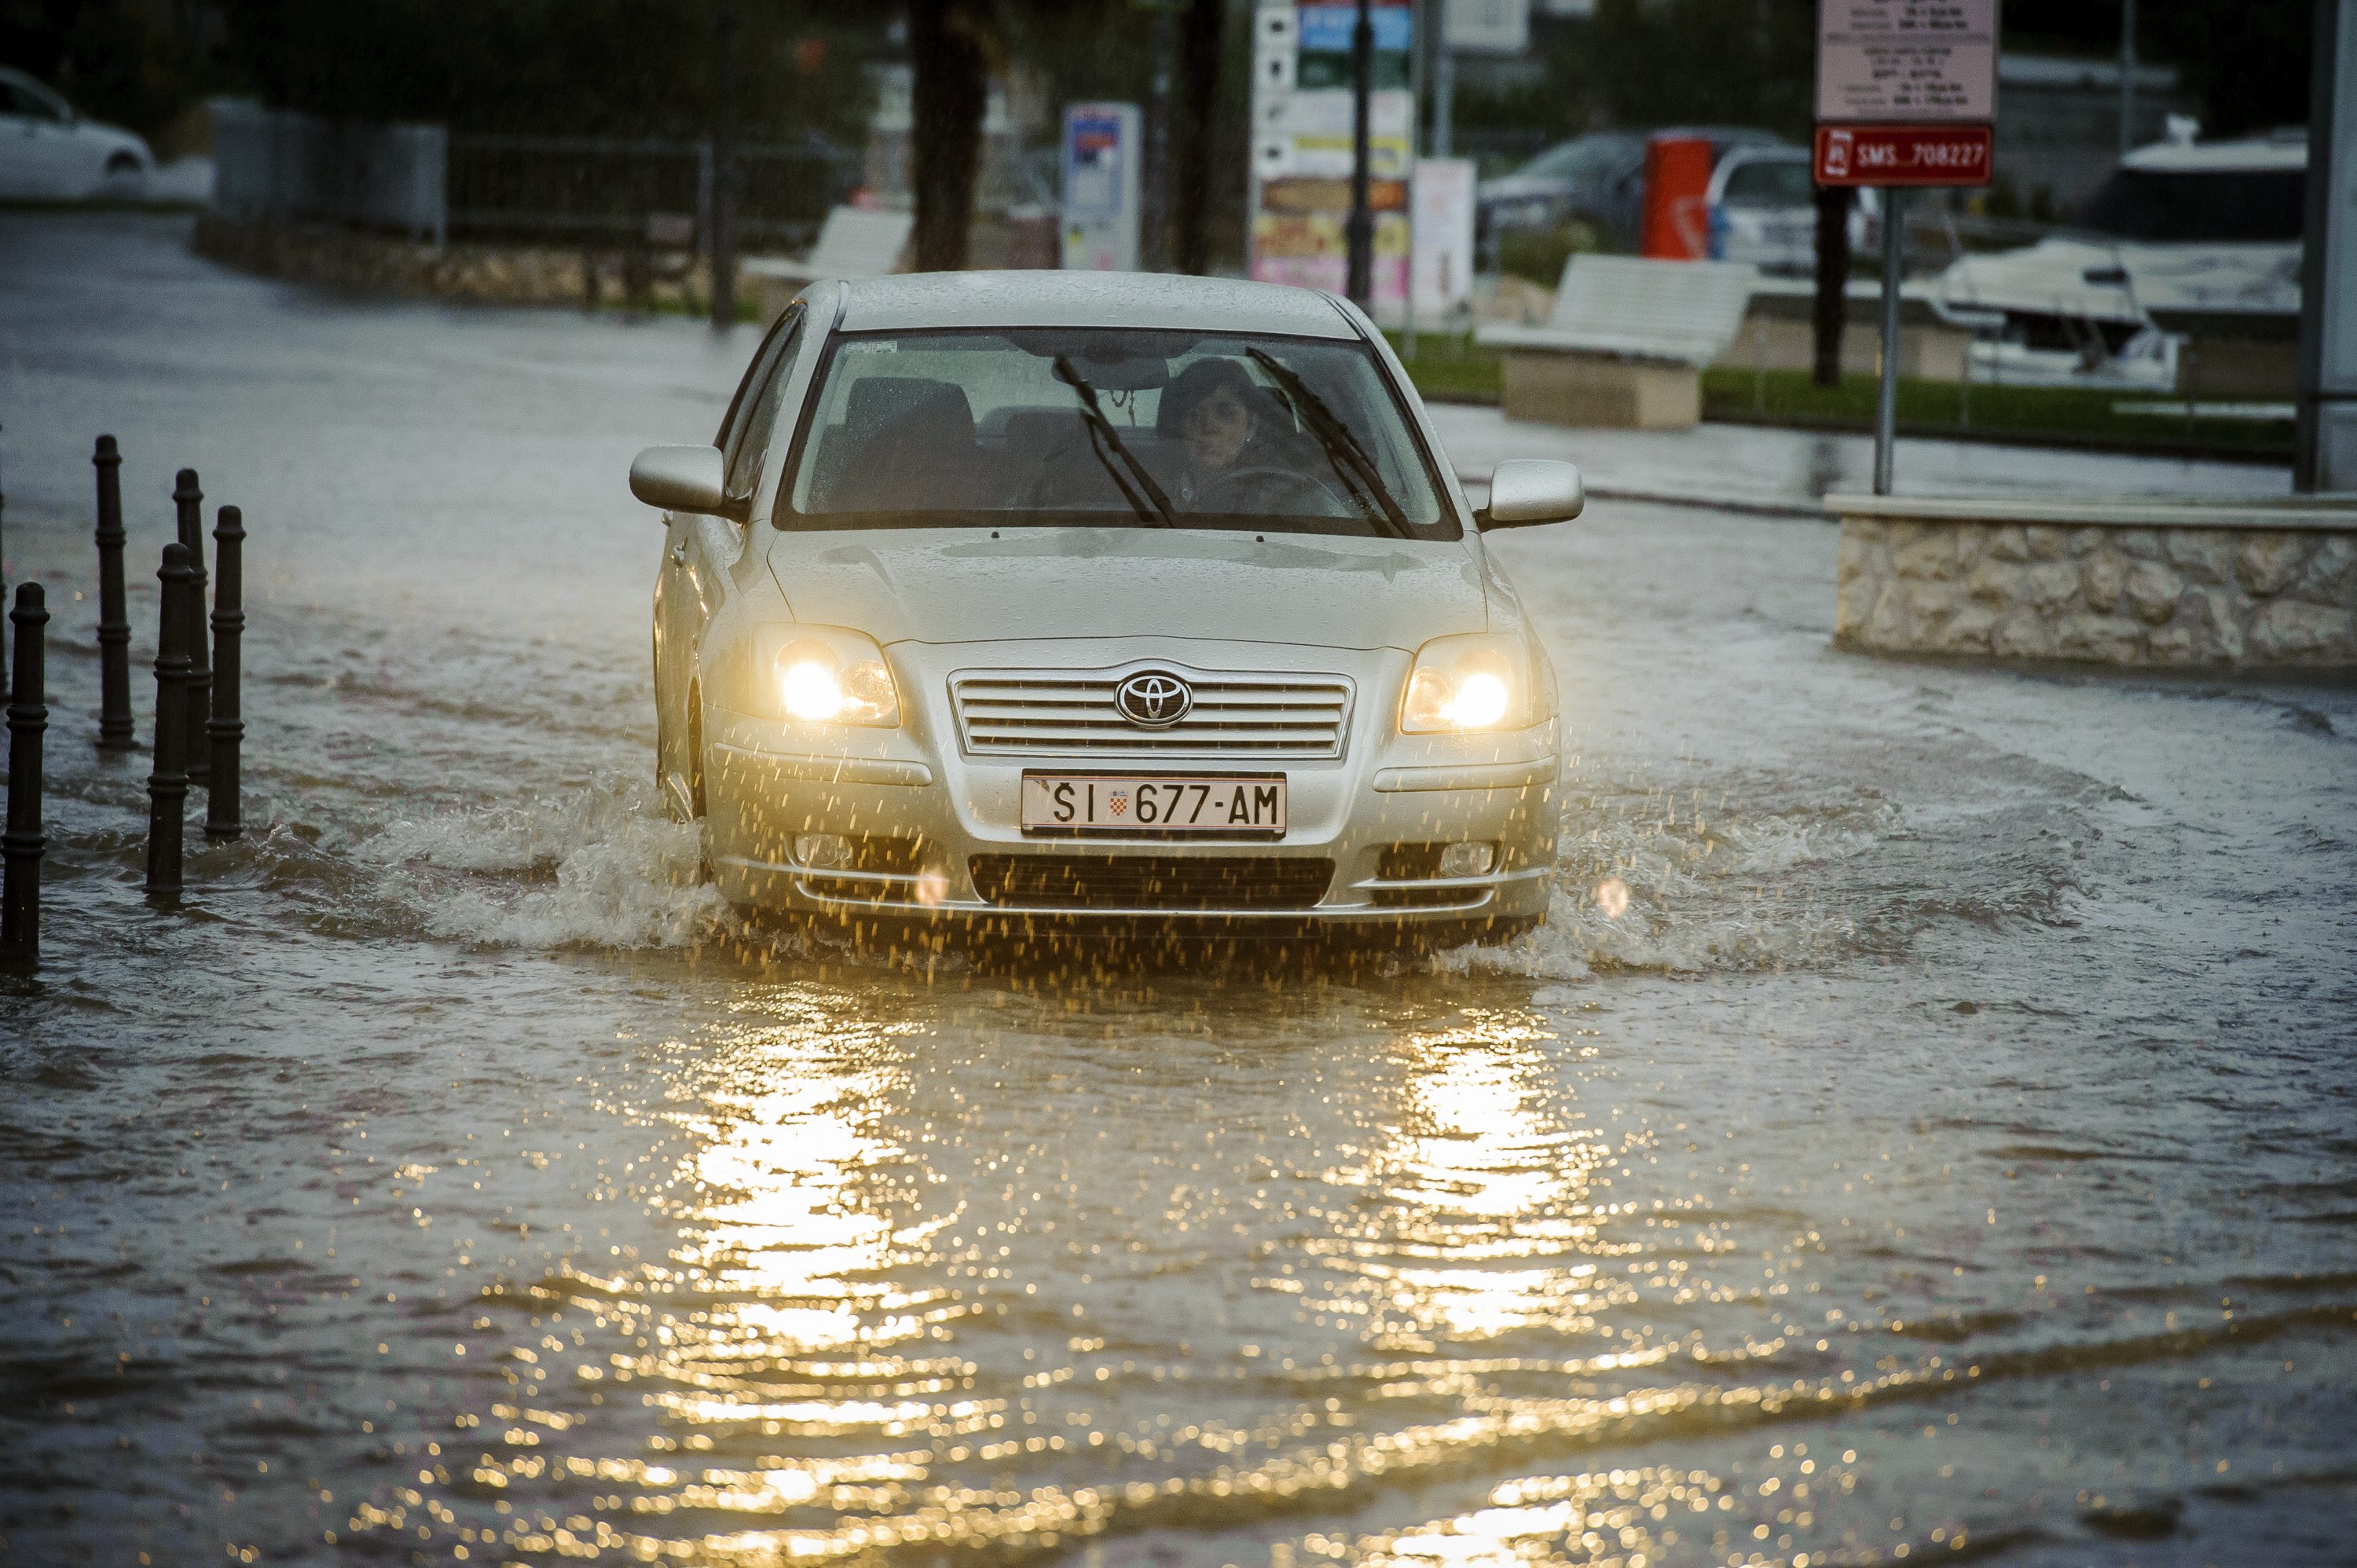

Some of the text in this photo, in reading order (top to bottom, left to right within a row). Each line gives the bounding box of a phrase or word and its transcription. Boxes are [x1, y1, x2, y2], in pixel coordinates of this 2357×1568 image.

[1857, 143, 1897, 167] SMS
[1054, 782, 1277, 825] ŠI 677-AM
